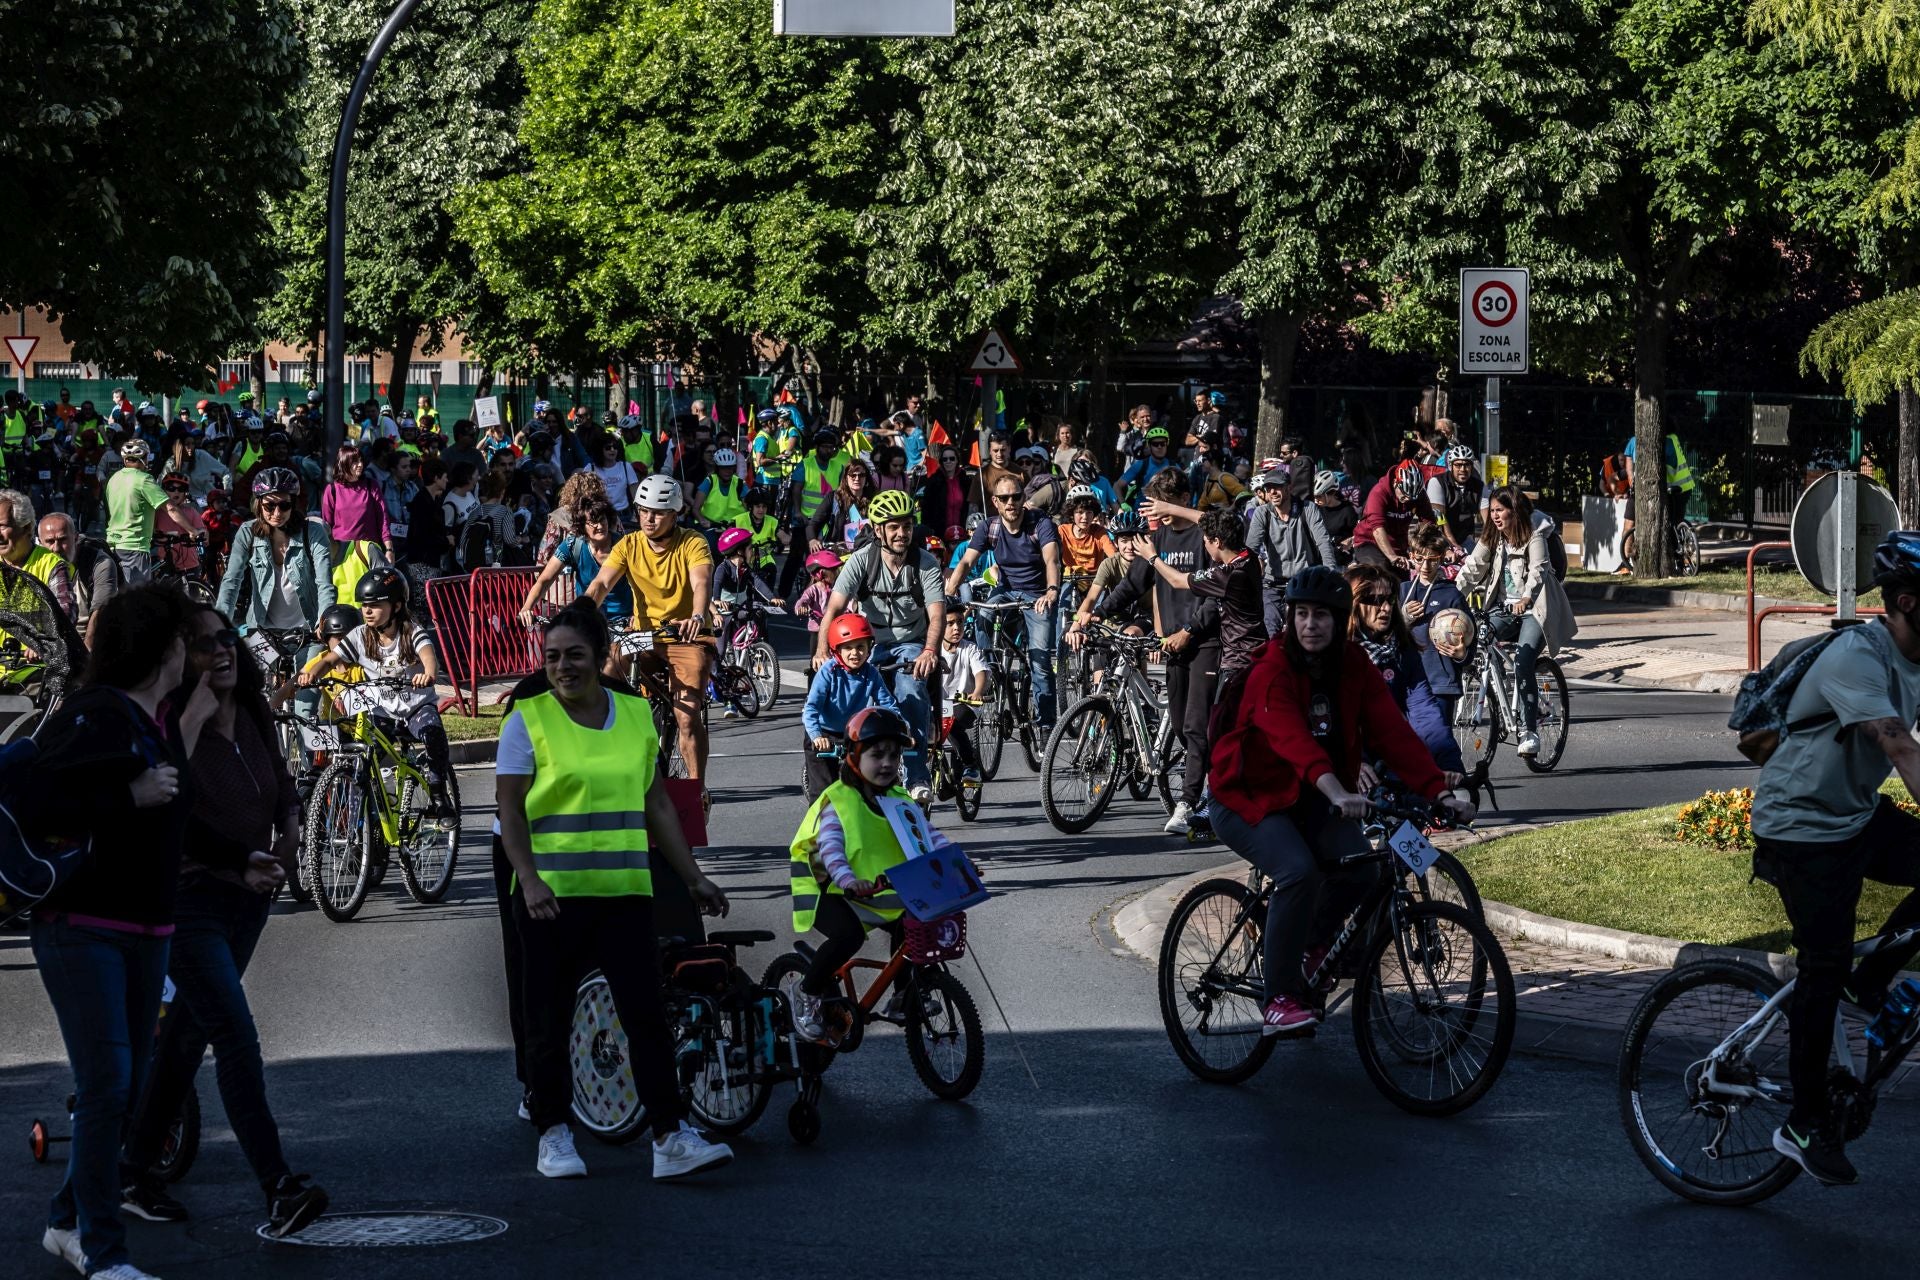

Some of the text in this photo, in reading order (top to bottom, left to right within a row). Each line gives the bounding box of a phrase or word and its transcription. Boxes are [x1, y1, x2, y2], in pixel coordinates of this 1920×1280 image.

[1482, 296, 1507, 312] 30
[1479, 335, 1510, 346] ZONA
[1468, 352, 1521, 362] ESCOLAR
